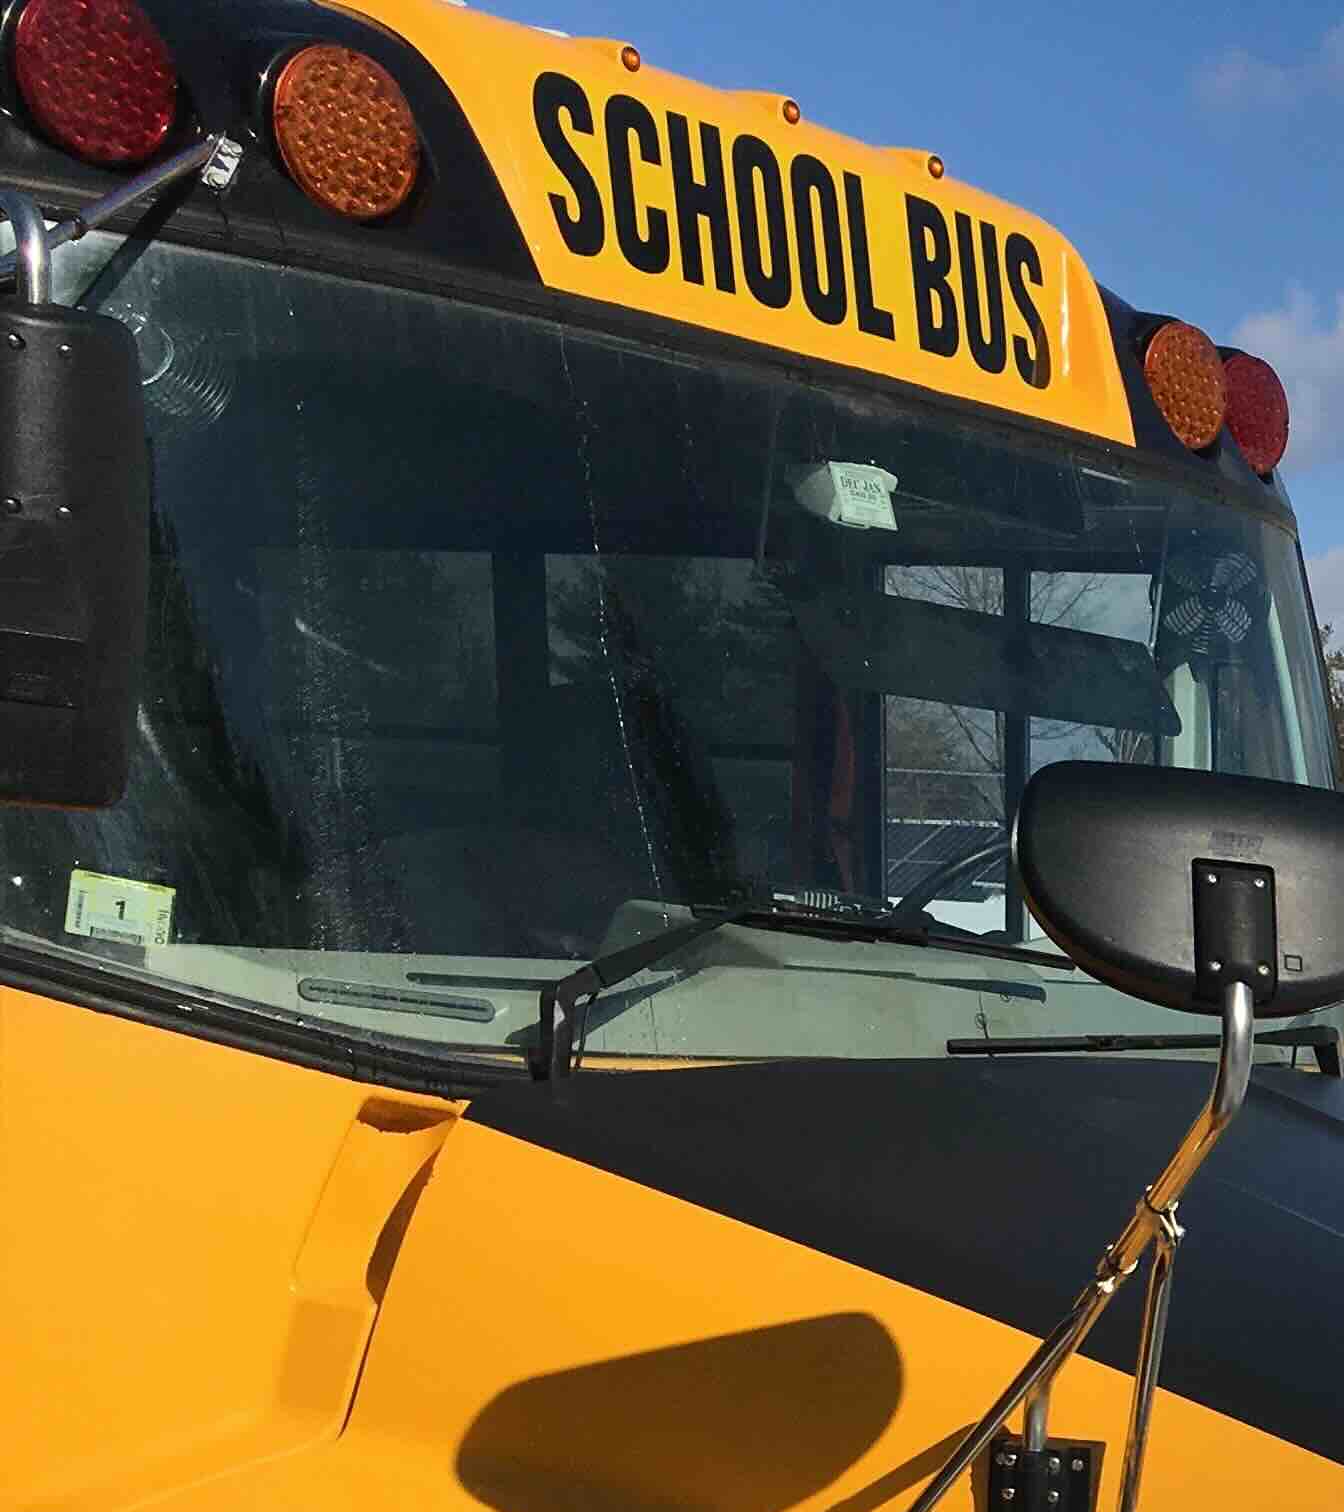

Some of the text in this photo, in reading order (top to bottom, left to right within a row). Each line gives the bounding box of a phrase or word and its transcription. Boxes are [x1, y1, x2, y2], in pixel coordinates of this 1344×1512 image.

[533, 71, 1052, 390] SCHOOL BUS
[114, 900, 126, 921] 1
